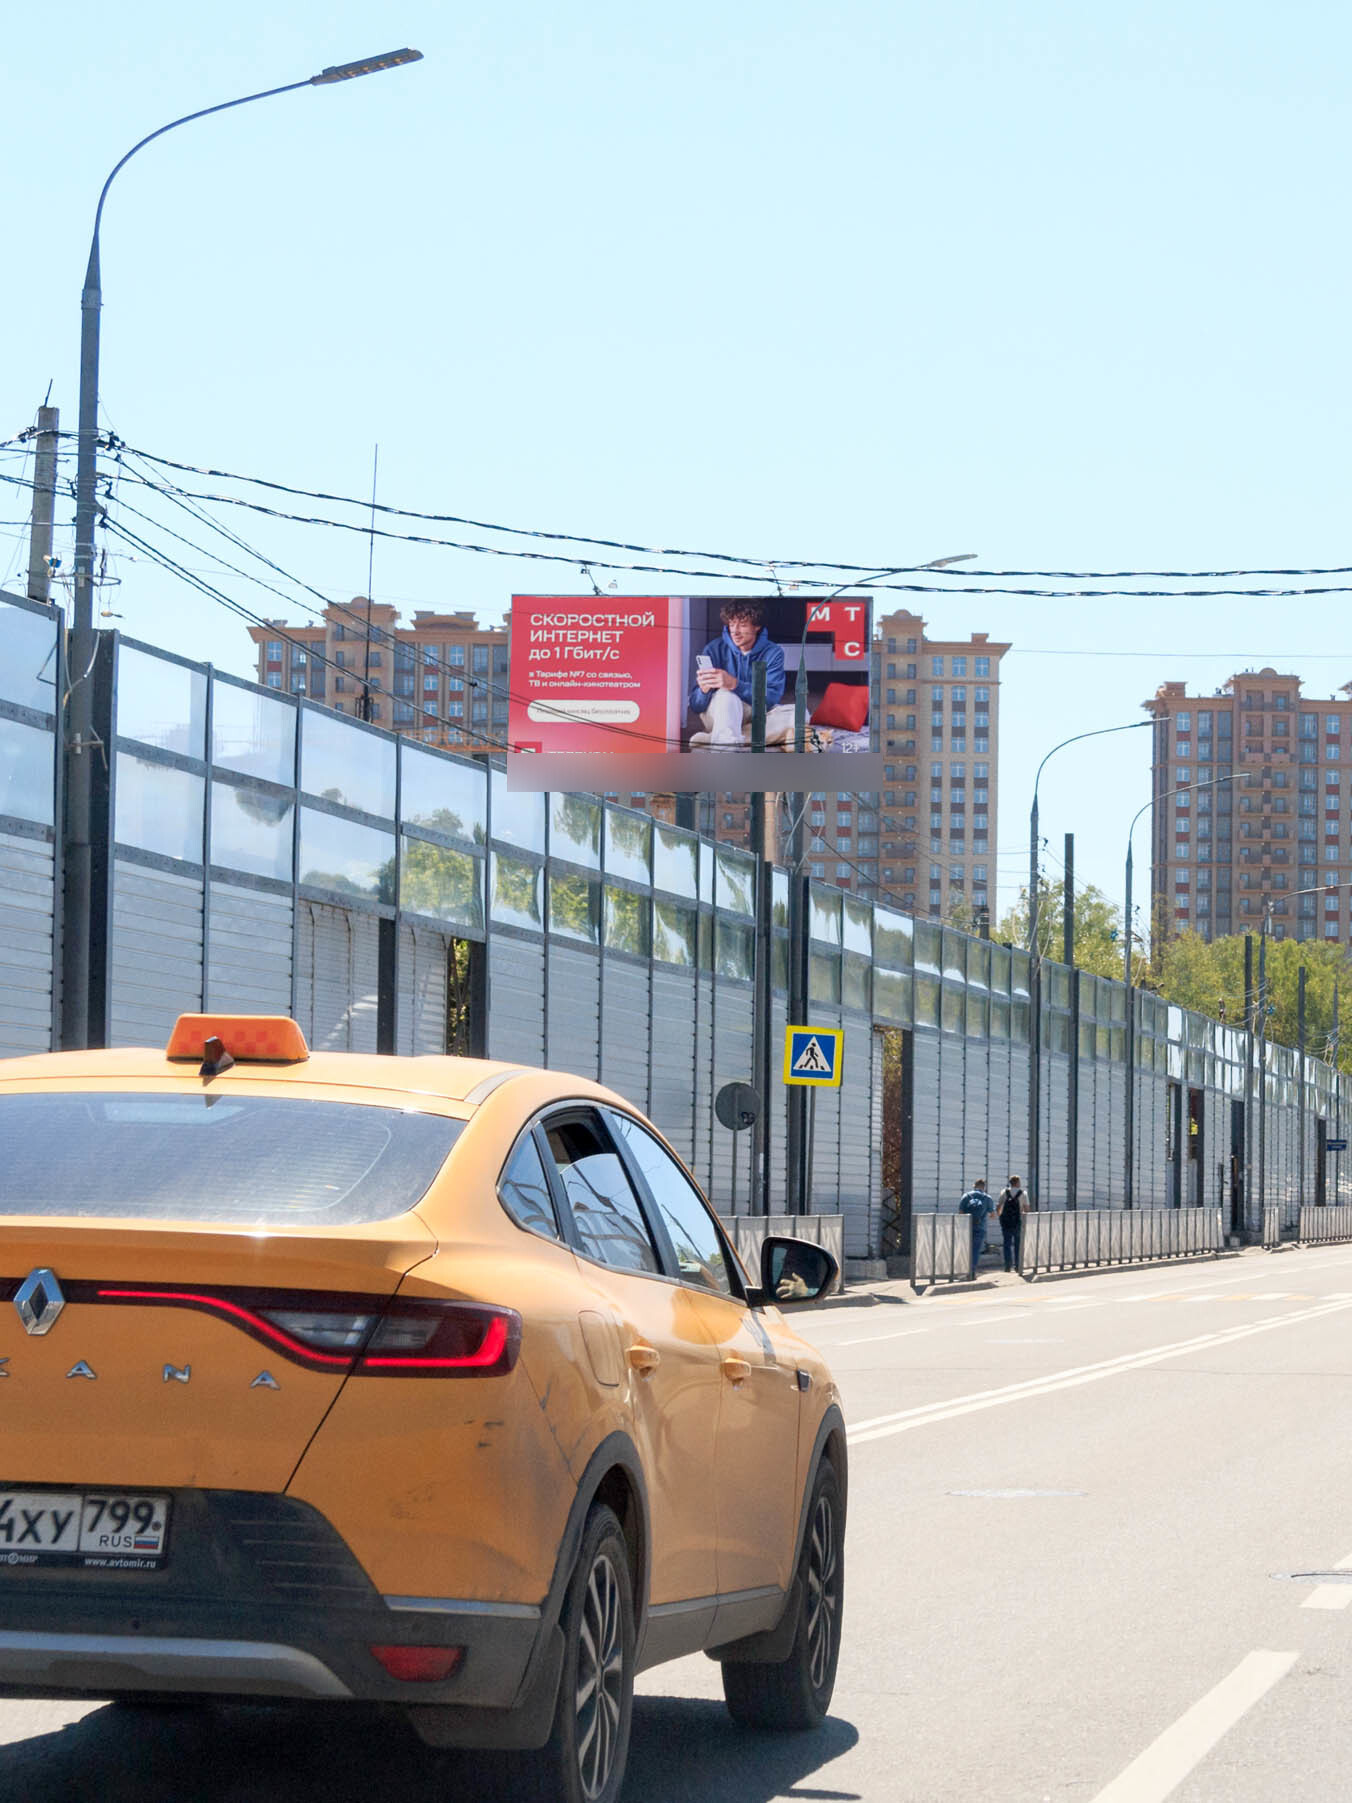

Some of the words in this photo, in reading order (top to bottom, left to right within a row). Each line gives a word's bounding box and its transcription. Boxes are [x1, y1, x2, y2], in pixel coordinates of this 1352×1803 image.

[530, 611, 655, 627] СКОРОСТНОЙ
[530, 629, 624, 643] ИНТЕРНЕТ
[529, 648, 551, 660] до
[554, 646, 561, 659] 1
[564, 646, 620, 661] Гбит/с
[535, 670, 569, 679] Тарифе
[86, 1499, 155, 1535] 799
[99, 1535, 132, 1548] RUS
[85, 1557, 157, 1569] www.avtomir.ru
